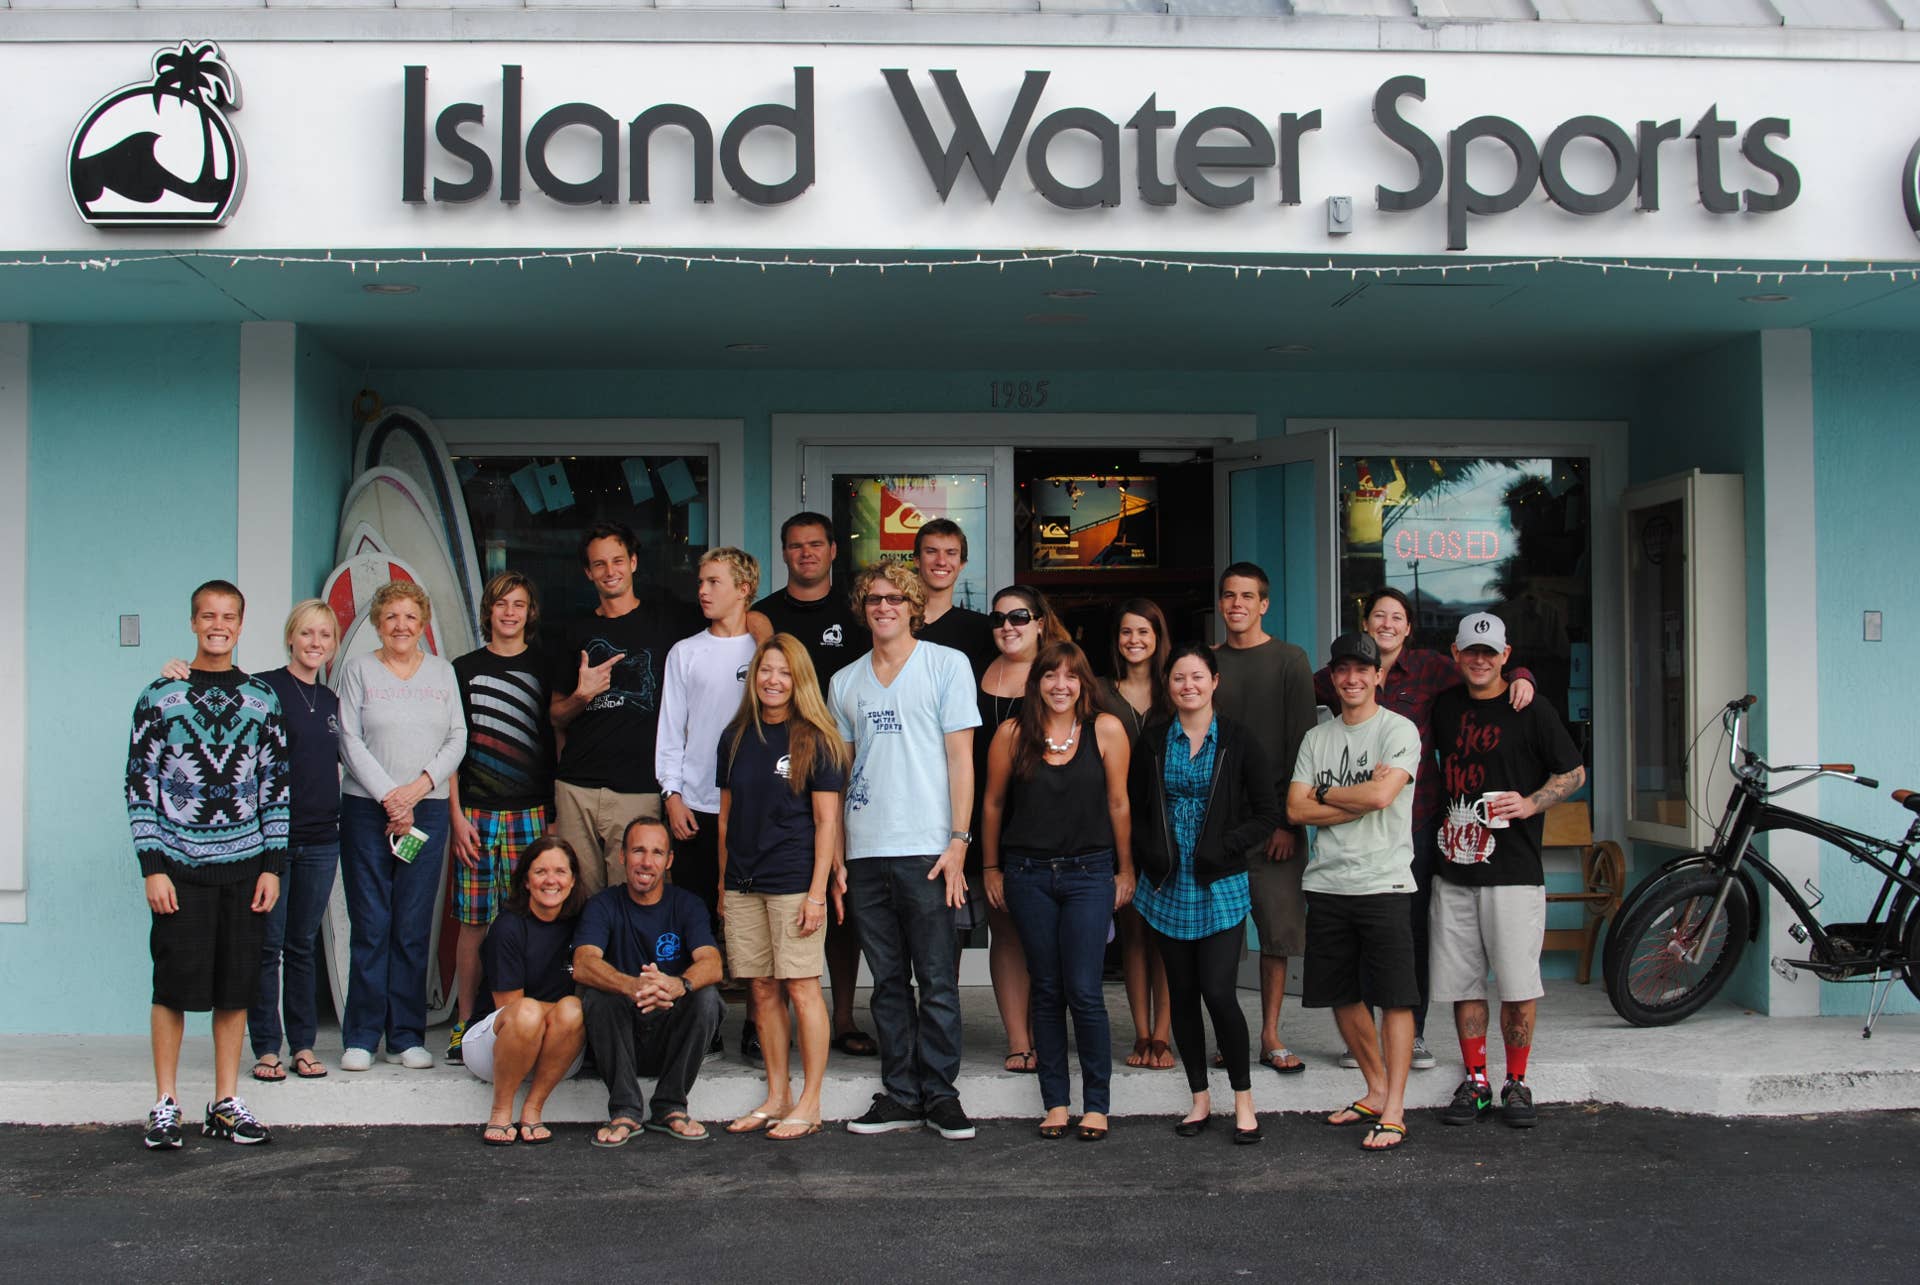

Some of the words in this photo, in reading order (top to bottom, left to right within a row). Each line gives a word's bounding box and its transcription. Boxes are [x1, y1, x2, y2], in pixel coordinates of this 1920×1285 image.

[403, 65, 815, 206] Island
[880, 68, 1322, 210] Water
[1372, 74, 1801, 251] Sports
[991, 380, 1049, 408] 1985
[1394, 530, 1500, 560] CLOSED
